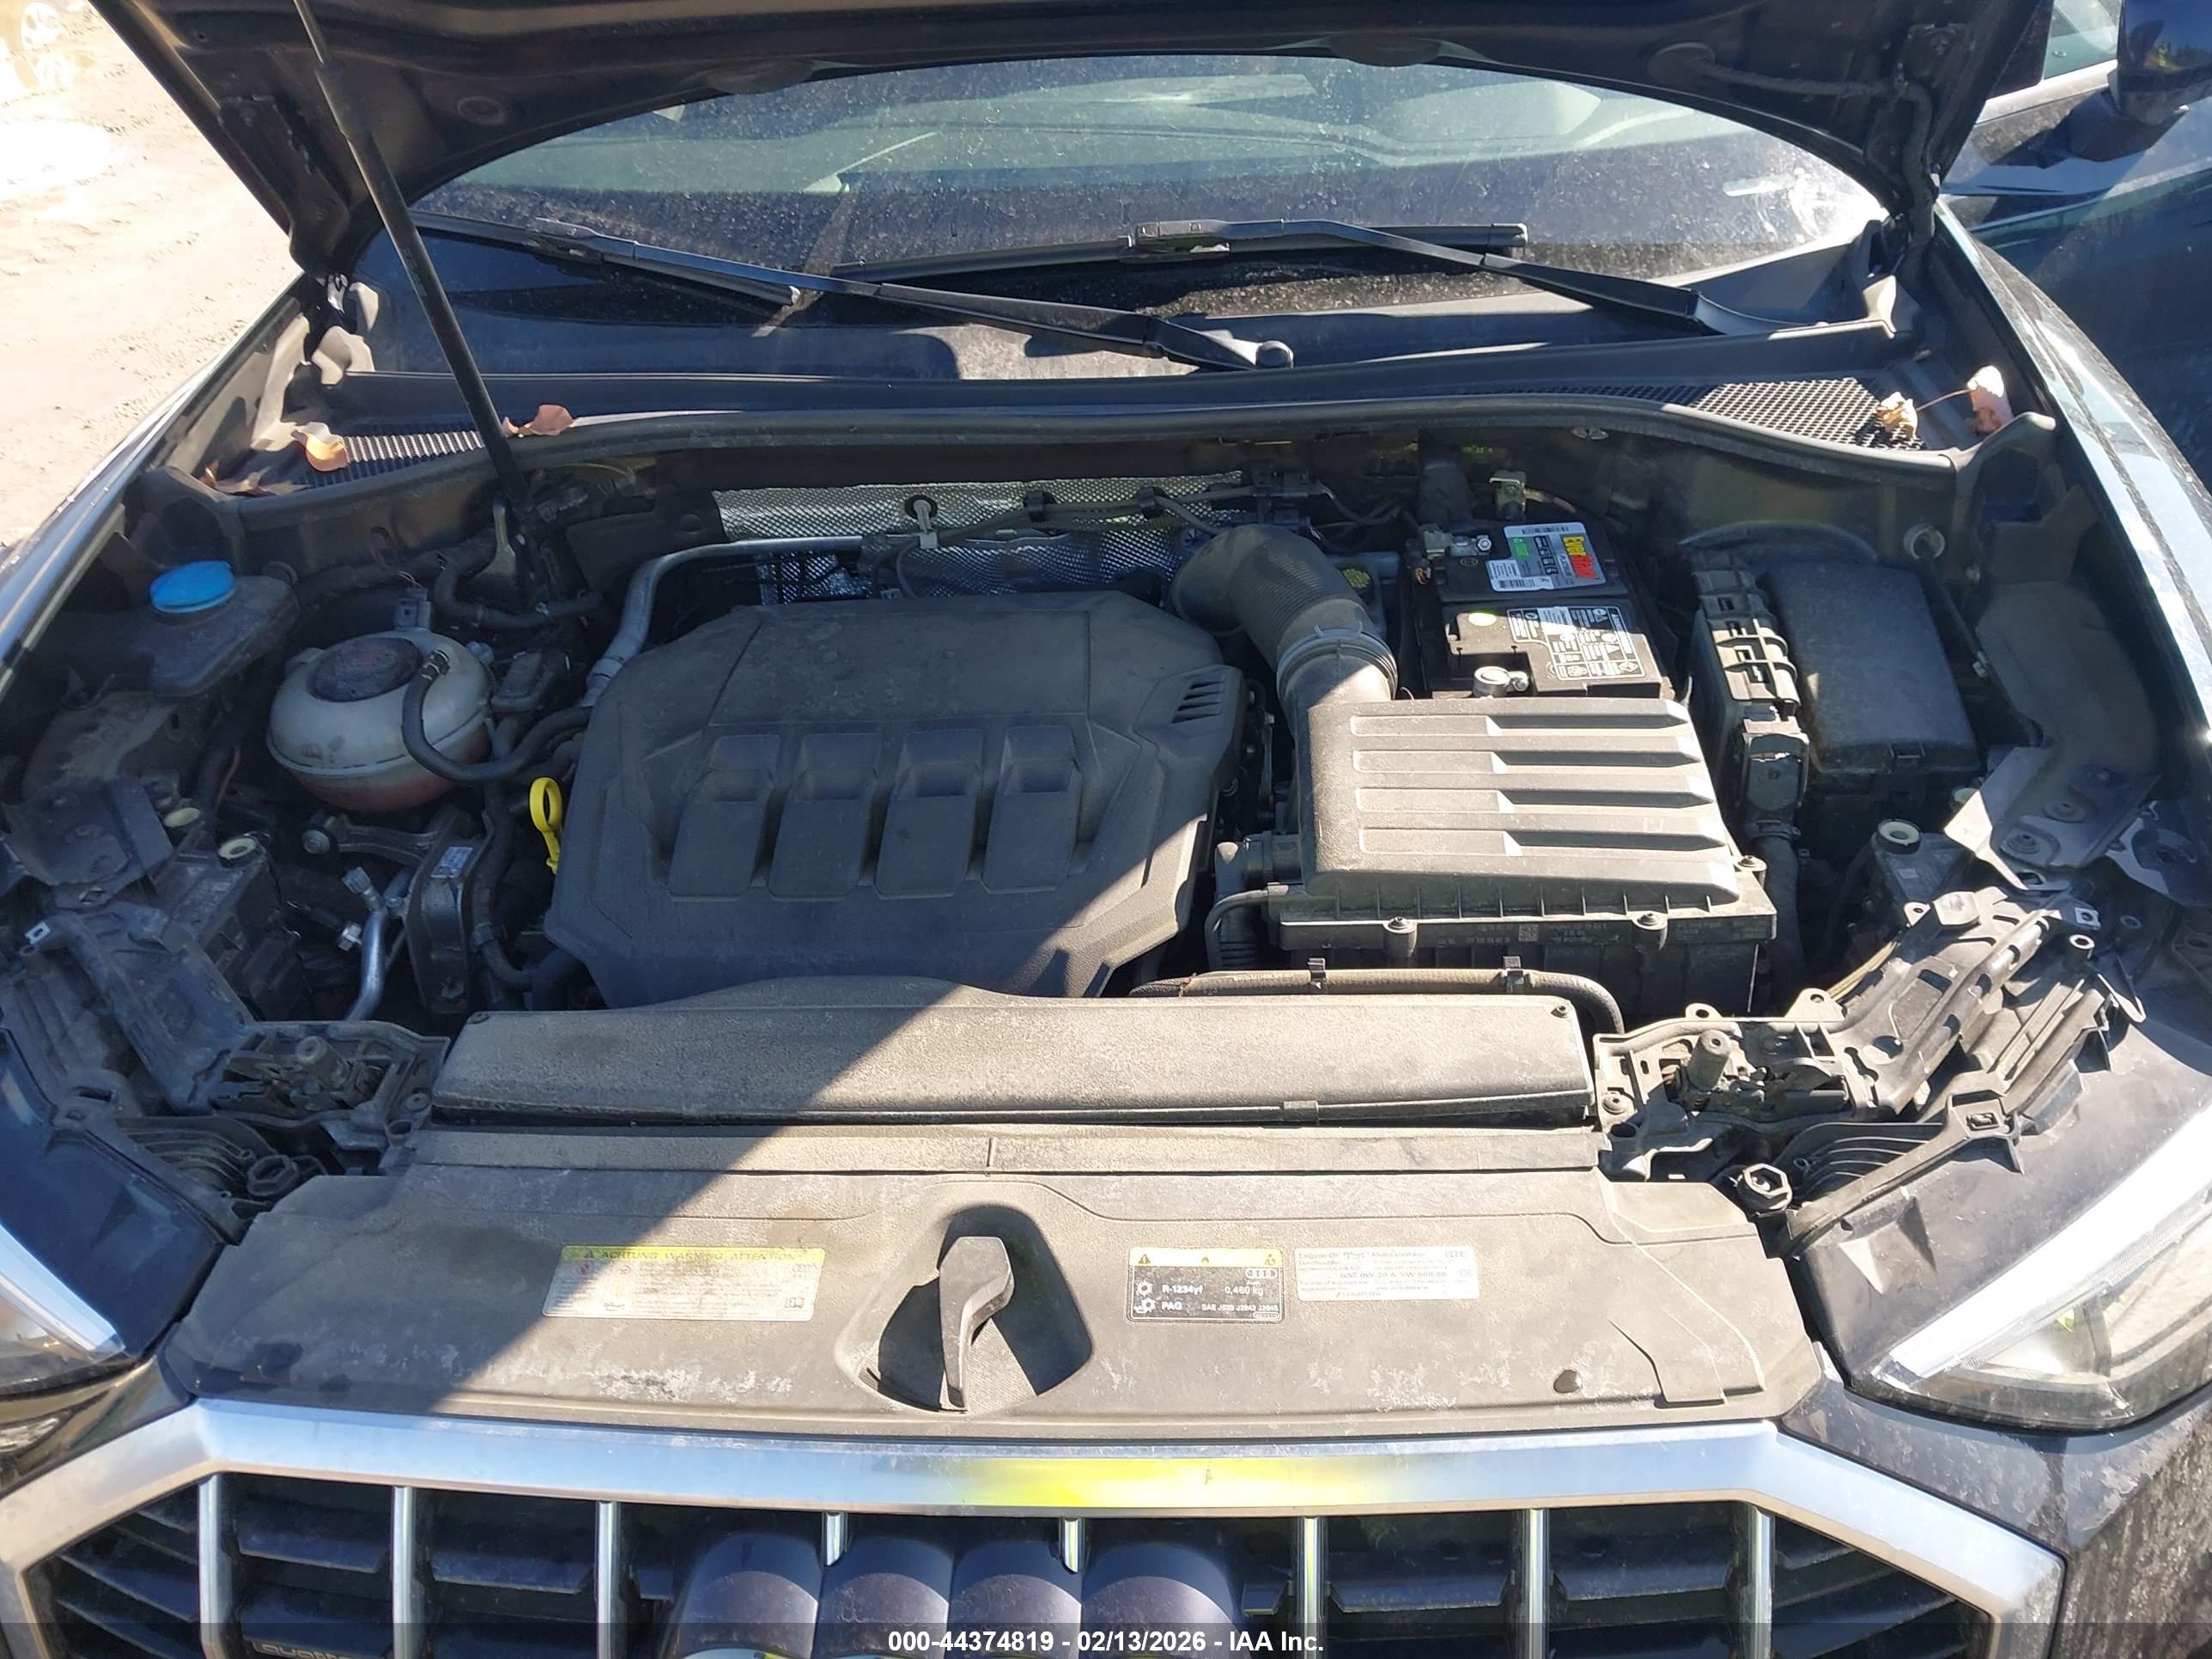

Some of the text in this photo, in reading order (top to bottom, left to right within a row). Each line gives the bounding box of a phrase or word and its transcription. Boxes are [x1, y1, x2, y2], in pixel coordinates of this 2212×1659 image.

[602, 1251, 796, 1261] ACHTUNG WARNING ATTENTION
[1162, 1285, 1203, 1295] R-1234yf
[1162, 1302, 1182, 1311] PAG
